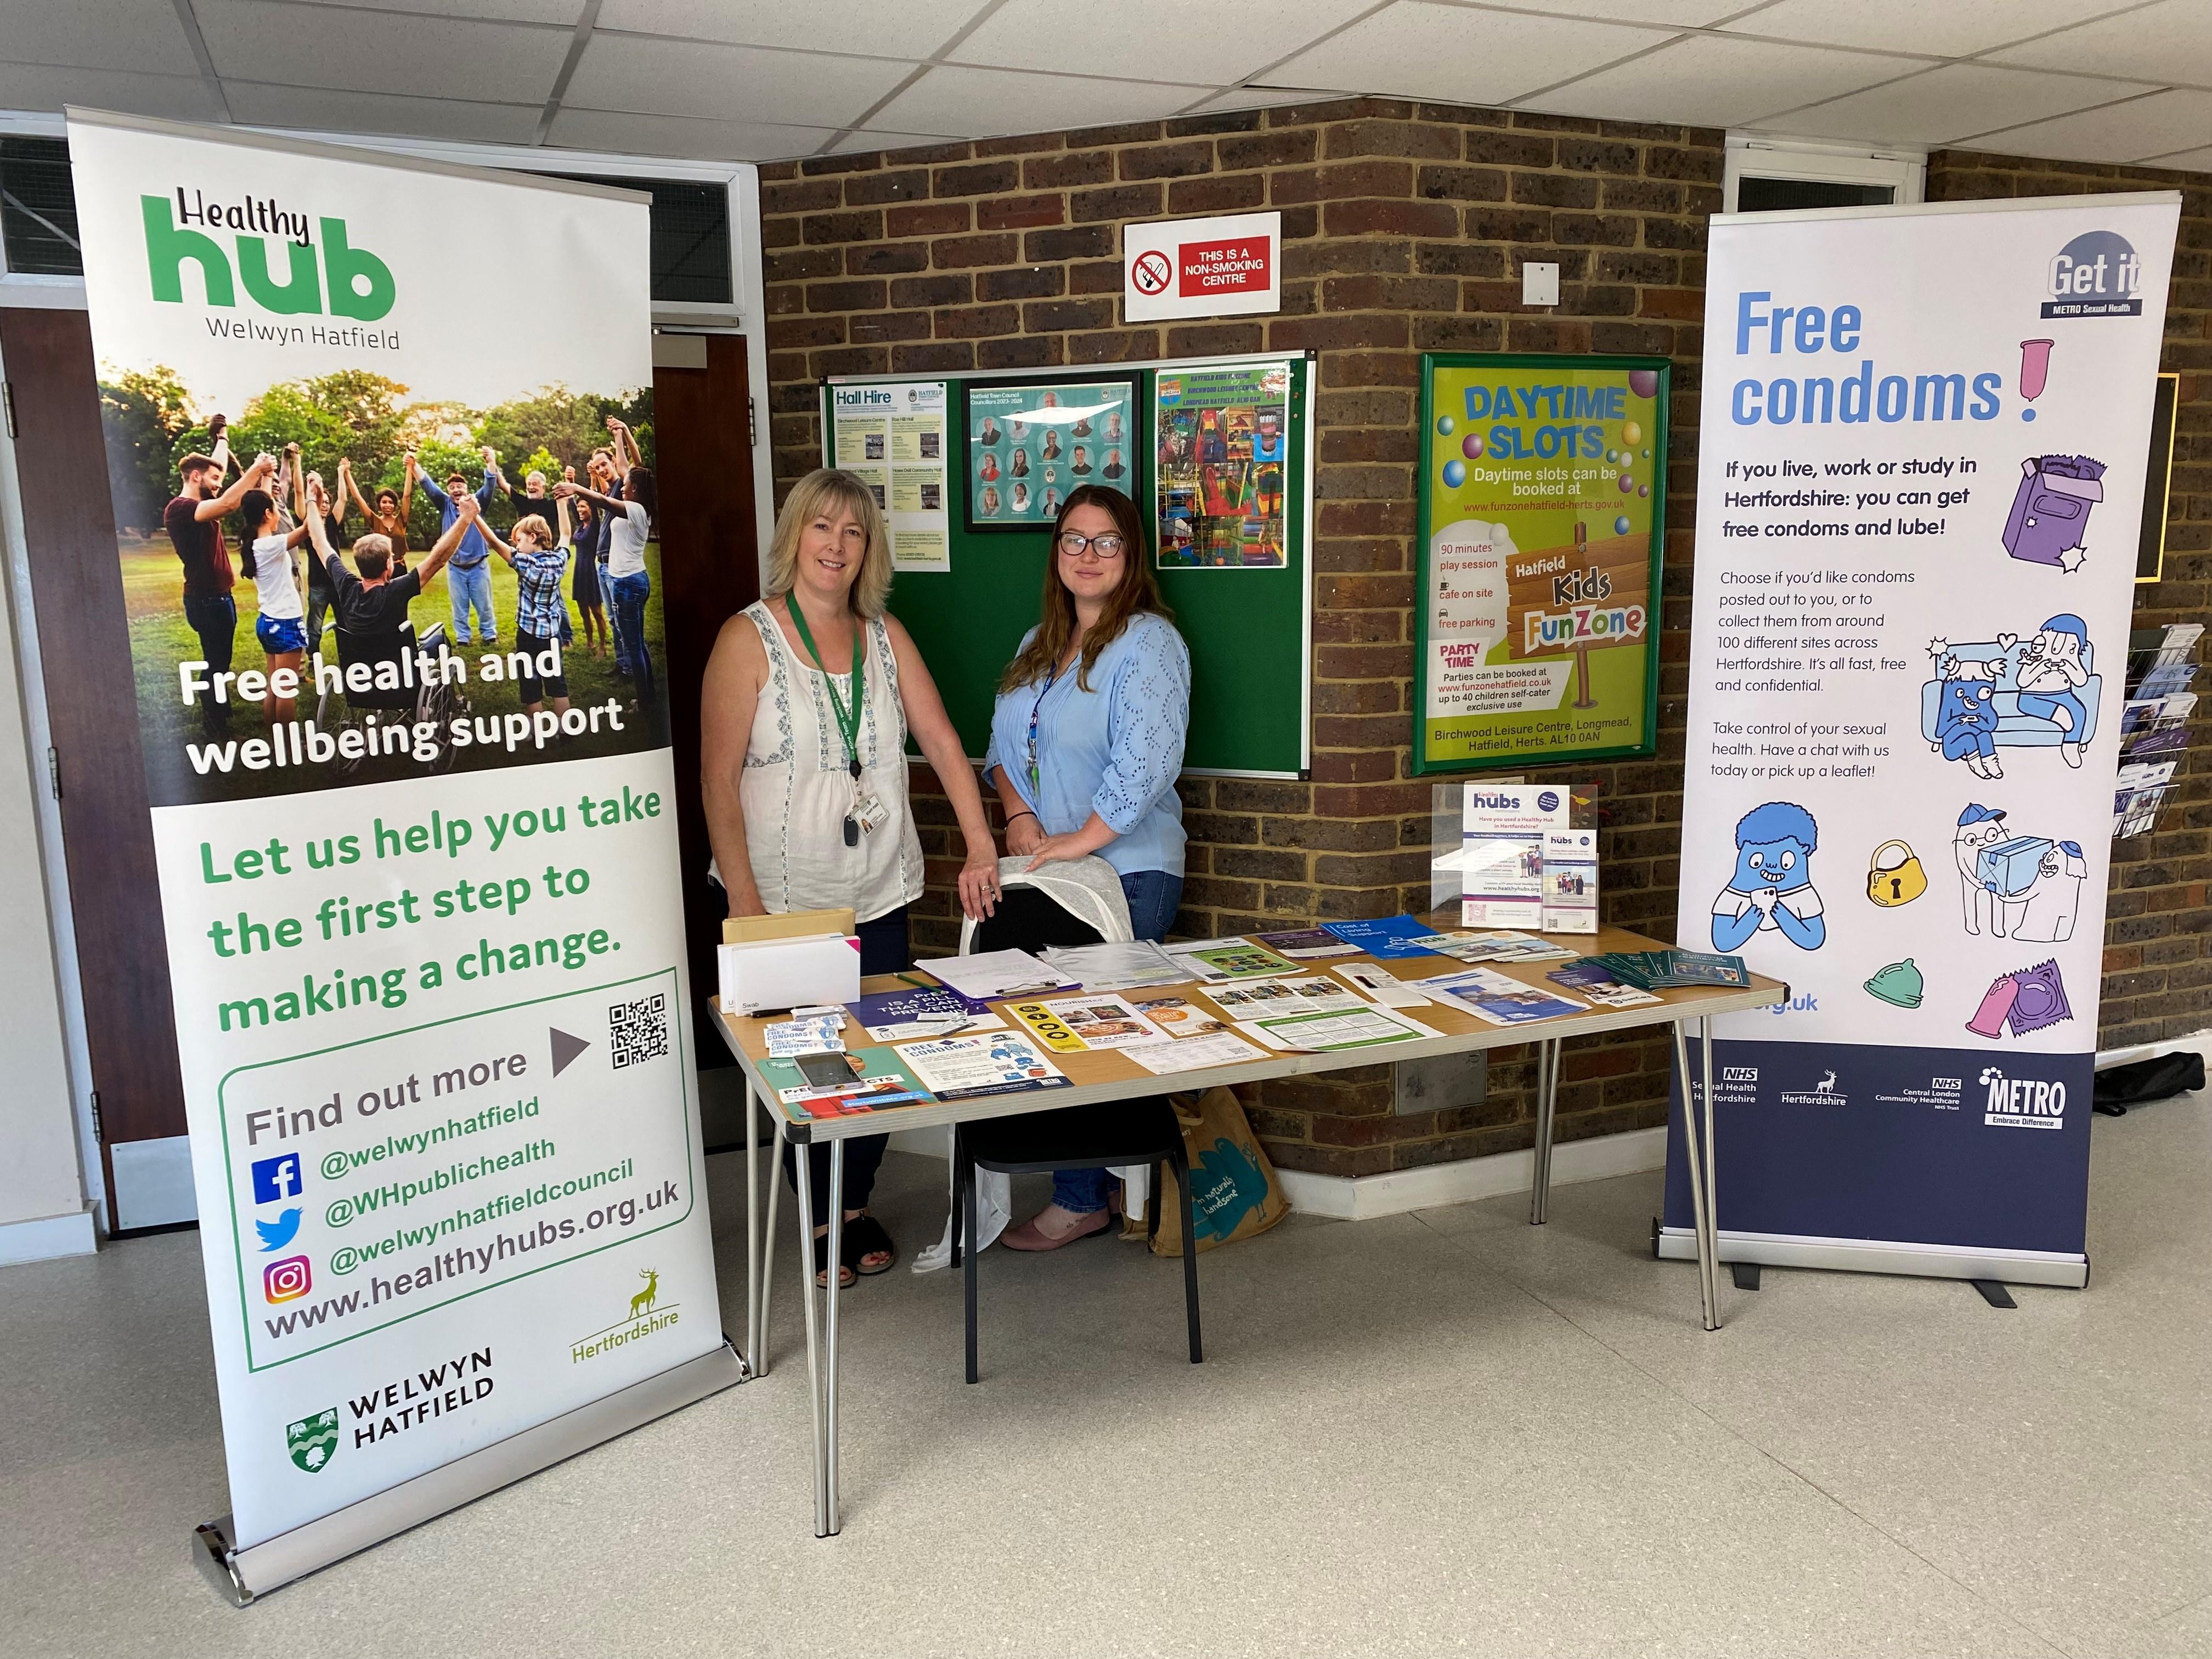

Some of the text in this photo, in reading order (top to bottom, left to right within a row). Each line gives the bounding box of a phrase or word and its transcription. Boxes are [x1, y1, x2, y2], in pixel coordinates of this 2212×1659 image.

[177, 187, 309, 247] Healthy
[140, 194, 396, 321] hub
[1199, 248, 1249, 262] THIS IS A
[1186, 259, 1263, 275] NON-SMOKING
[2047, 253, 2141, 295] Get it
[1203, 273, 1246, 286] CENTRE
[2053, 303, 2130, 314] METRO Sexual Health
[1736, 291, 1862, 356] Free
[205, 318, 399, 350] Welwyn Hatfield
[837, 390, 891, 404] Hall Hire
[1464, 384, 1627, 420] DAYTIME
[1487, 425, 1604, 460] SLOTS
[1474, 466, 1617, 484] Daytime slots can be
[1726, 456, 1976, 481] If you live, work or study in
[1513, 482, 1581, 496] booked at
[1464, 499, 1624, 512] www.funzonehatfield-herts.gov.uk
[1725, 488, 1970, 510] Hertfordshire: you can get
[1723, 518, 1945, 537] free condoms and lube!
[1441, 543, 1492, 554] 90 minutes
[1440, 560, 1498, 572] play session
[1516, 555, 1566, 578] Hatfield
[1439, 590, 1460, 600] cafe
[1476, 589, 1493, 597] site
[1553, 566, 1612, 606] Kids
[1439, 617, 1496, 629] free parking
[1527, 608, 1644, 647] FunZone
[1440, 643, 1480, 656] PARTY
[1444, 656, 1474, 668] TIME
[178, 638, 562, 706] Free health and
[1443, 668, 1547, 682] Parties can be booked at
[1438, 678, 1551, 693] www.funzonehatfield.co.uk
[1438, 696, 1449, 704] up
[1475, 691, 1509, 701] children
[1511, 688, 1550, 699] self-cater
[1466, 701, 1505, 712] exclusive
[185, 697, 624, 775] wellbeing support
[1435, 716, 1632, 741] Birchwood Leisure Centre, Longmead,
[1469, 732, 1600, 752] Hatfield, Herts. AL10 0AN
[1474, 793, 1520, 809] hubs
[200, 786, 661, 884] Let us help you take
[207, 866, 590, 958] the first step to
[1413, 936, 1446, 944] hub
[219, 929, 620, 1032] making a change.
[877, 1003, 920, 1012] THAT
[891, 1003, 963, 1015] PREVENT
[904, 1043, 934, 1053] FREE
[1725, 1069, 1756, 1079] NHS
[1934, 1079, 1959, 1088] NHS
[1726, 1084, 1756, 1092] Health
[1987, 1078, 2066, 1116] METRO
[246, 1054, 527, 1146] Find out more
[1782, 1094, 1846, 1105] Hertfordshire
[1875, 1094, 1960, 1105] Community Healthcare
[1993, 1116, 2054, 1127] Embrace Difference
[320, 1097, 539, 1180] @welwynhatfield
[325, 1138, 556, 1229] @WHpublichealth
[1205, 1176, 1235, 1200] naturally
[330, 1159, 633, 1275] @welwynhatfieldcouncil
[264, 1178, 679, 1340] www.healthyhubs.org.uk
[572, 1309, 679, 1363] Hertfordshire
[348, 1347, 493, 1419] WELWYN
[354, 1377, 494, 1449] HATFIELD
